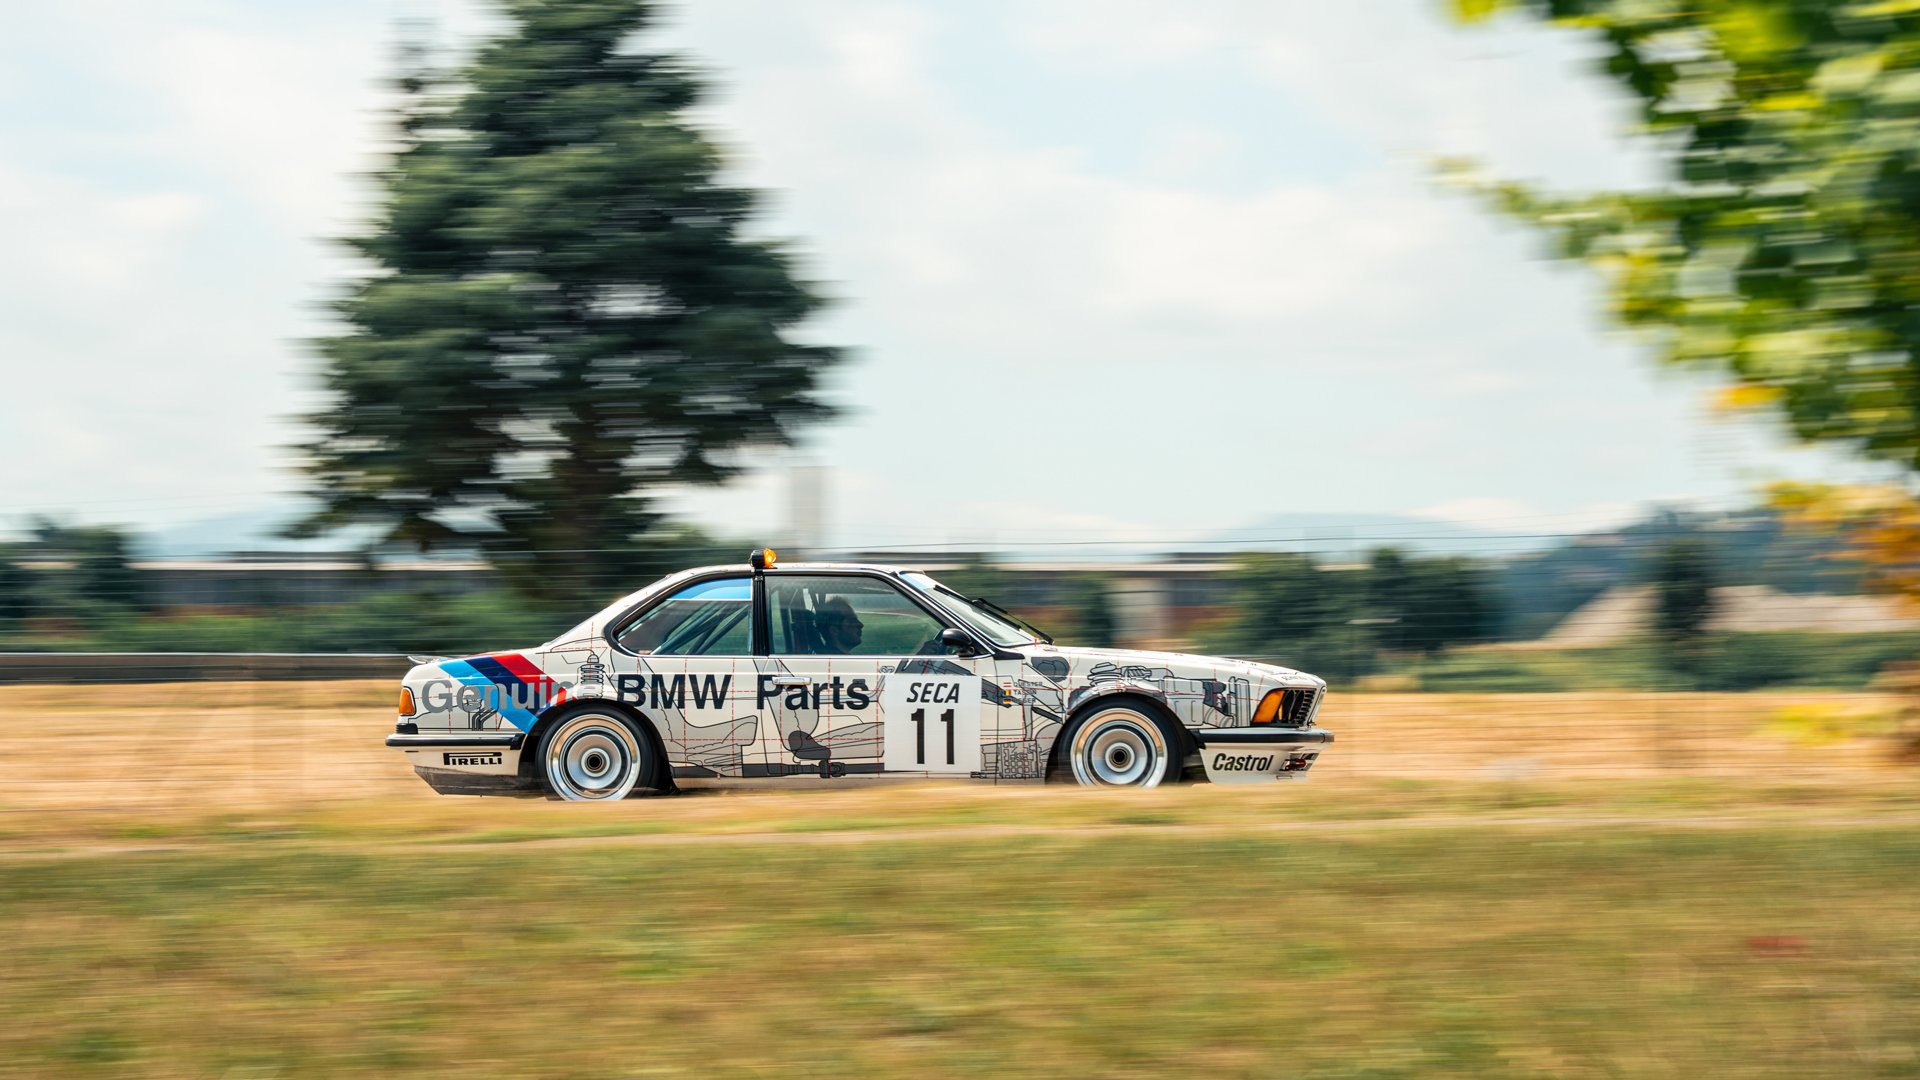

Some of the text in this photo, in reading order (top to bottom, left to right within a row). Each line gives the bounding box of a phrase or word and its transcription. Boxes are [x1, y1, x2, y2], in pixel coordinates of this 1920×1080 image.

[617, 674, 732, 710] BMW
[756, 674, 870, 711] Parts
[906, 682, 960, 704] SECA
[910, 708, 955, 765] 11
[442, 752, 502, 766] PIRELLI
[1212, 753, 1274, 771] Castrol
